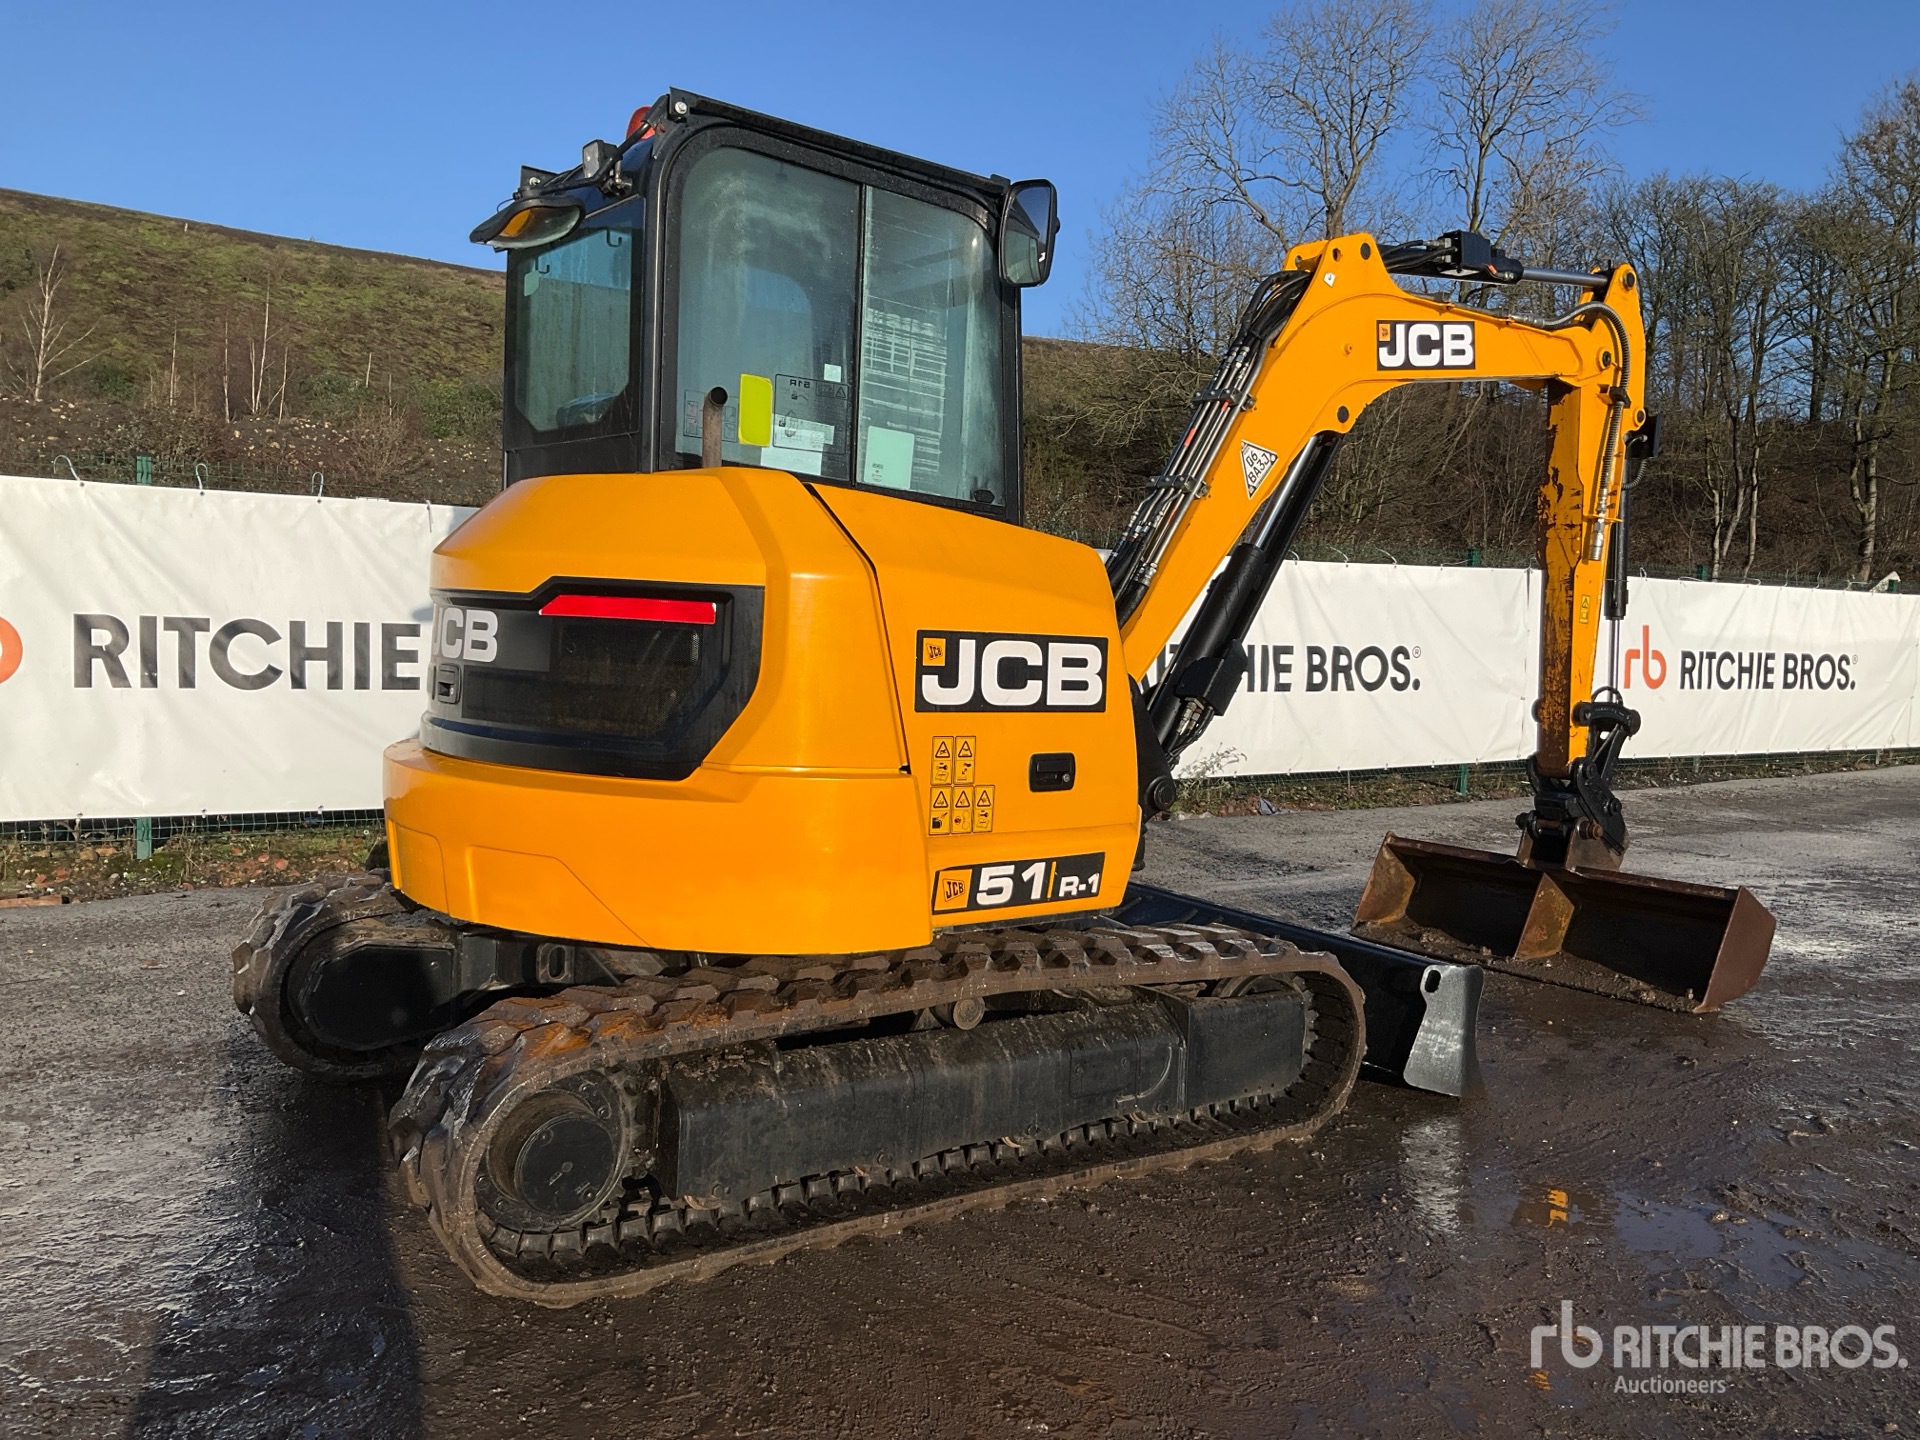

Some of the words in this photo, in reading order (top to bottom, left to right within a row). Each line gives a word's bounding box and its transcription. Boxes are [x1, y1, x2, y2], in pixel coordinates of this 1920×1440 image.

[1378, 323, 1474, 367] JCB
[73, 613, 421, 690] RITCHIE
[921, 638, 1103, 707] JCB
[1680, 650, 1775, 690] RITCHIE
[945, 881, 964, 899] JCB
[976, 862, 1047, 906] 51
[1058, 871, 1100, 898] R-1
